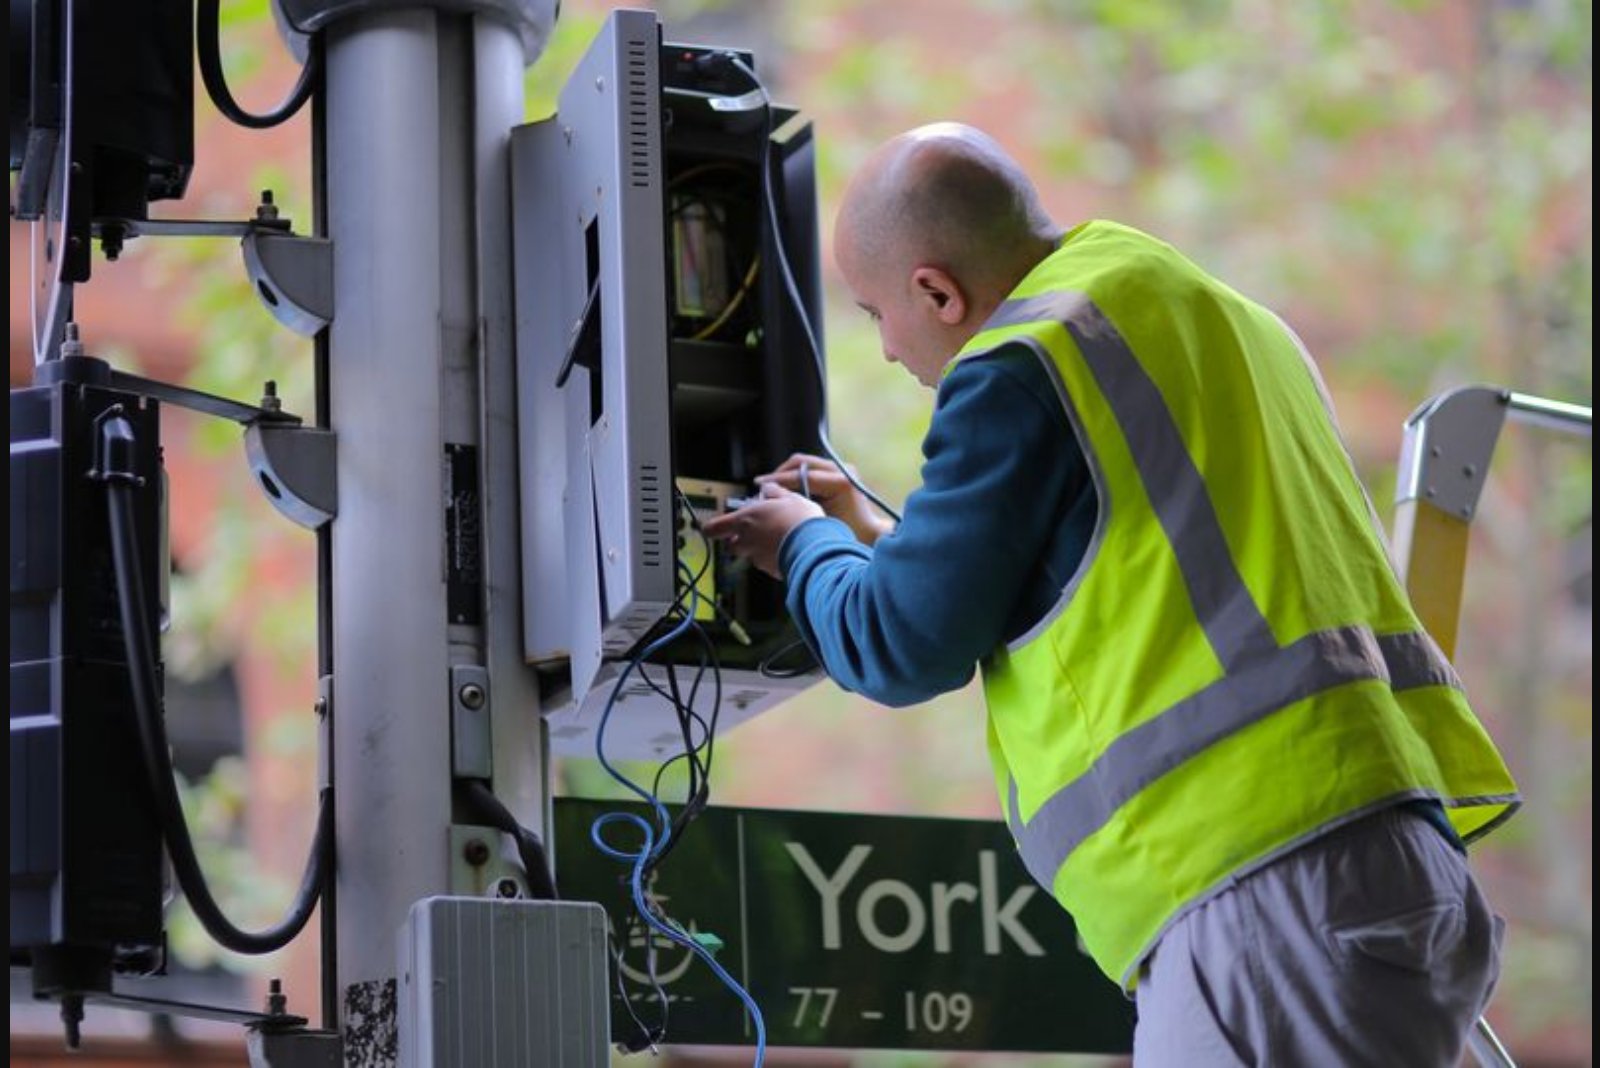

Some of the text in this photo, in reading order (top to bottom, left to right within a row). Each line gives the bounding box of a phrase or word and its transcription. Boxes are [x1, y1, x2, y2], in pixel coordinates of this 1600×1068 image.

[785, 842, 1047, 957] York
[789, 987, 838, 1028] 77
[905, 991, 972, 1032] 109
